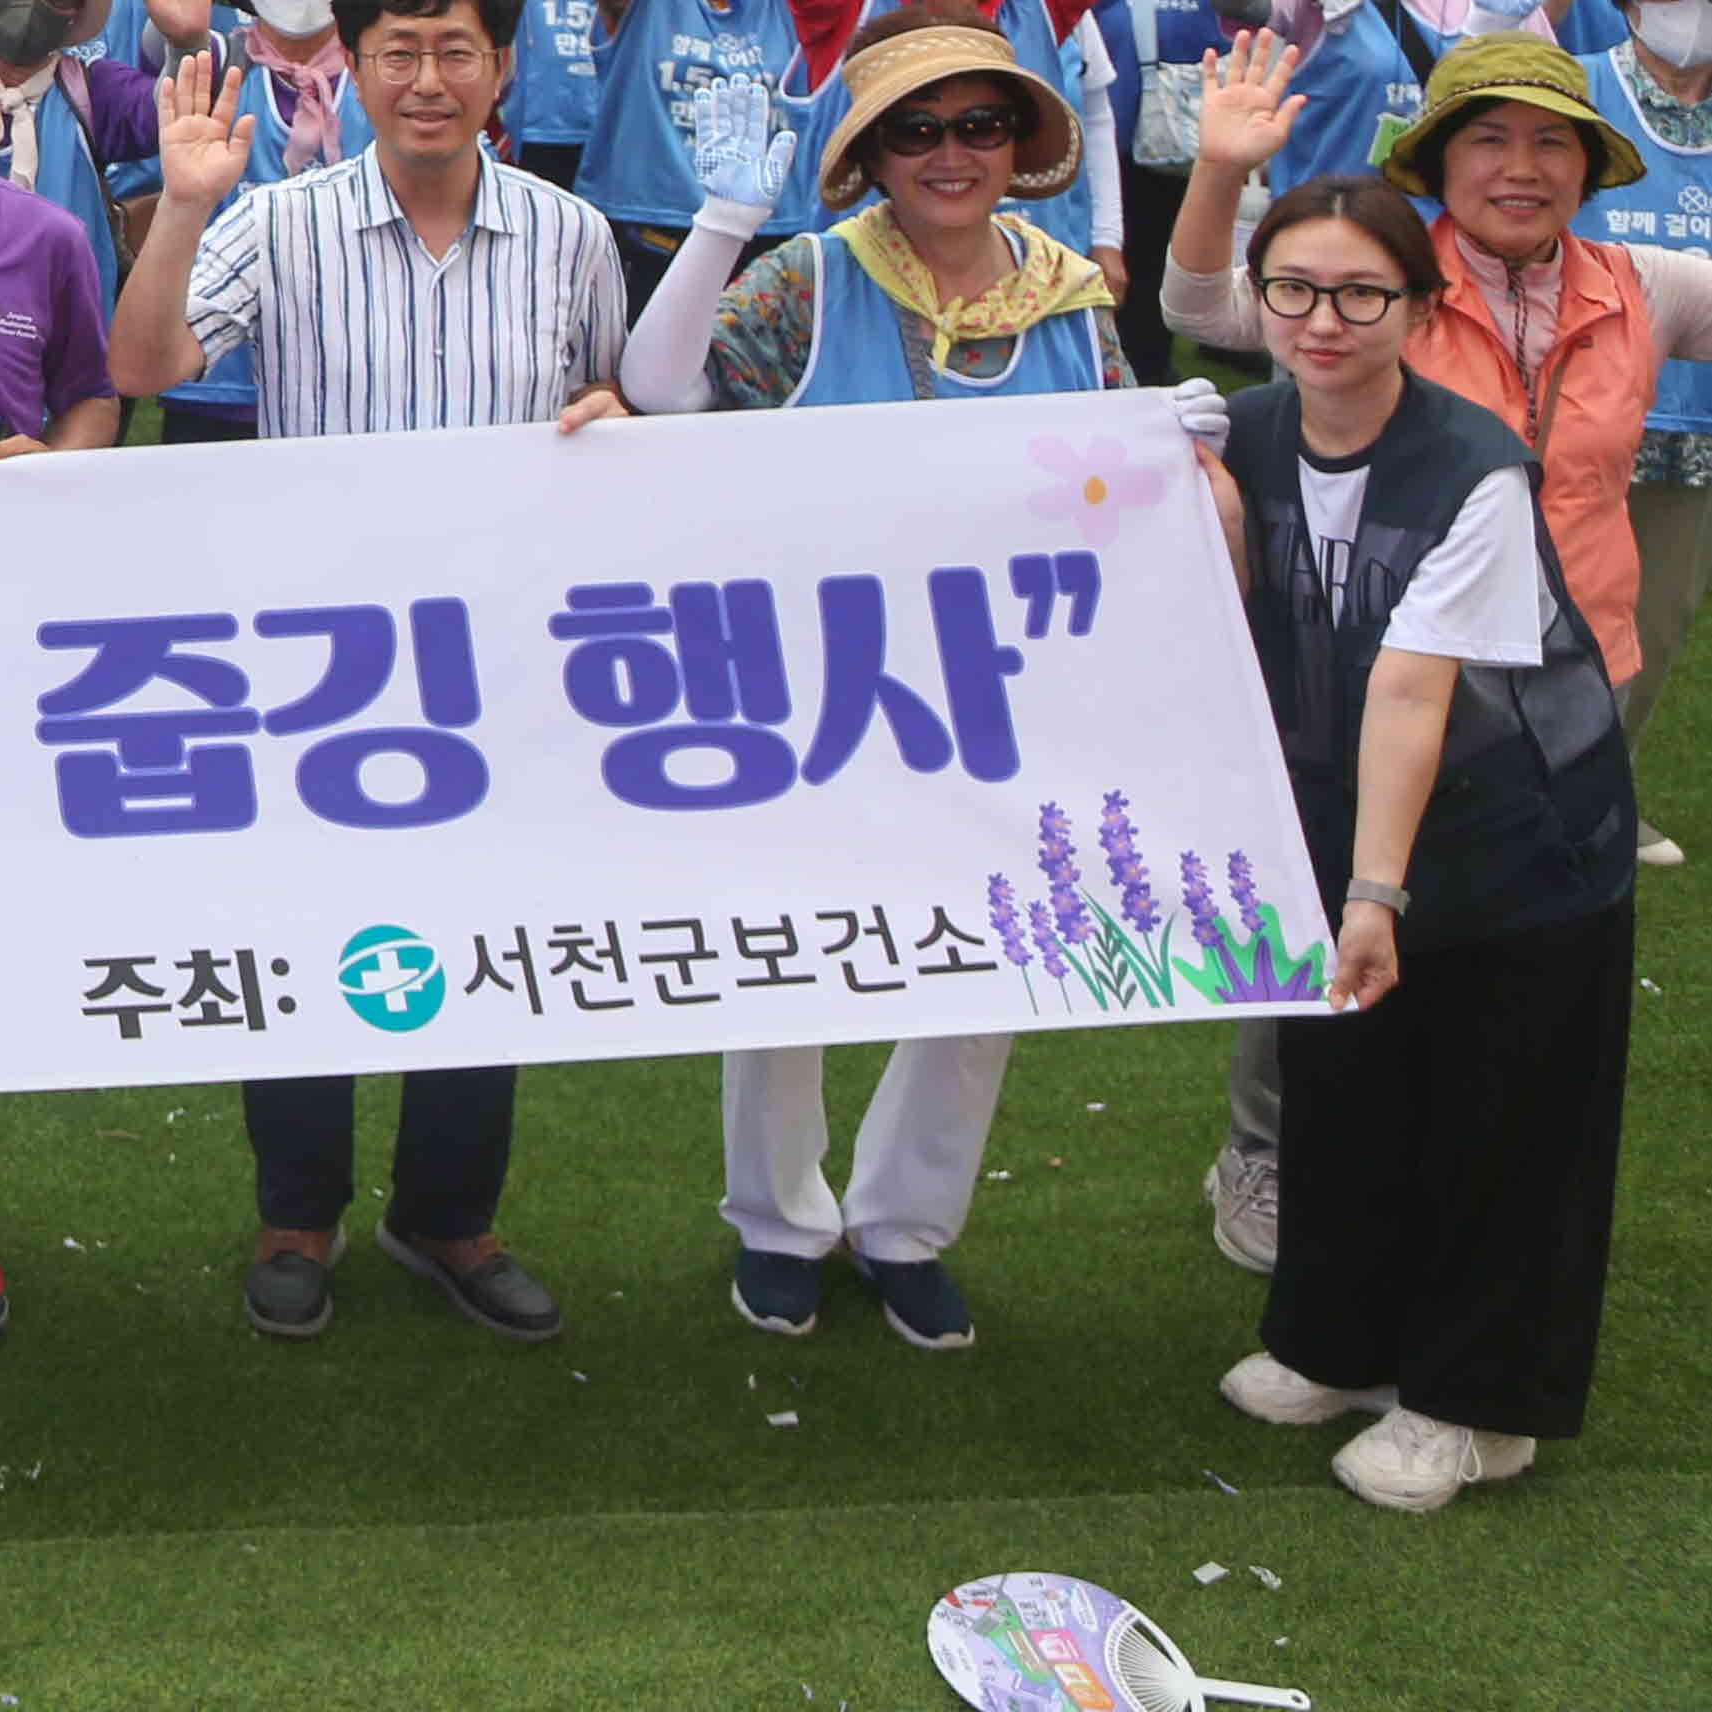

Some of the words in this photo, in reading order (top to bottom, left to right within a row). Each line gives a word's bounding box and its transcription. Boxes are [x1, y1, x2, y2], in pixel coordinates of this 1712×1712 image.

[33, 594, 492, 841] 줍깅
[81, 949, 298, 1040] 주최:
[463, 905, 1000, 1018] 서천군보건소
